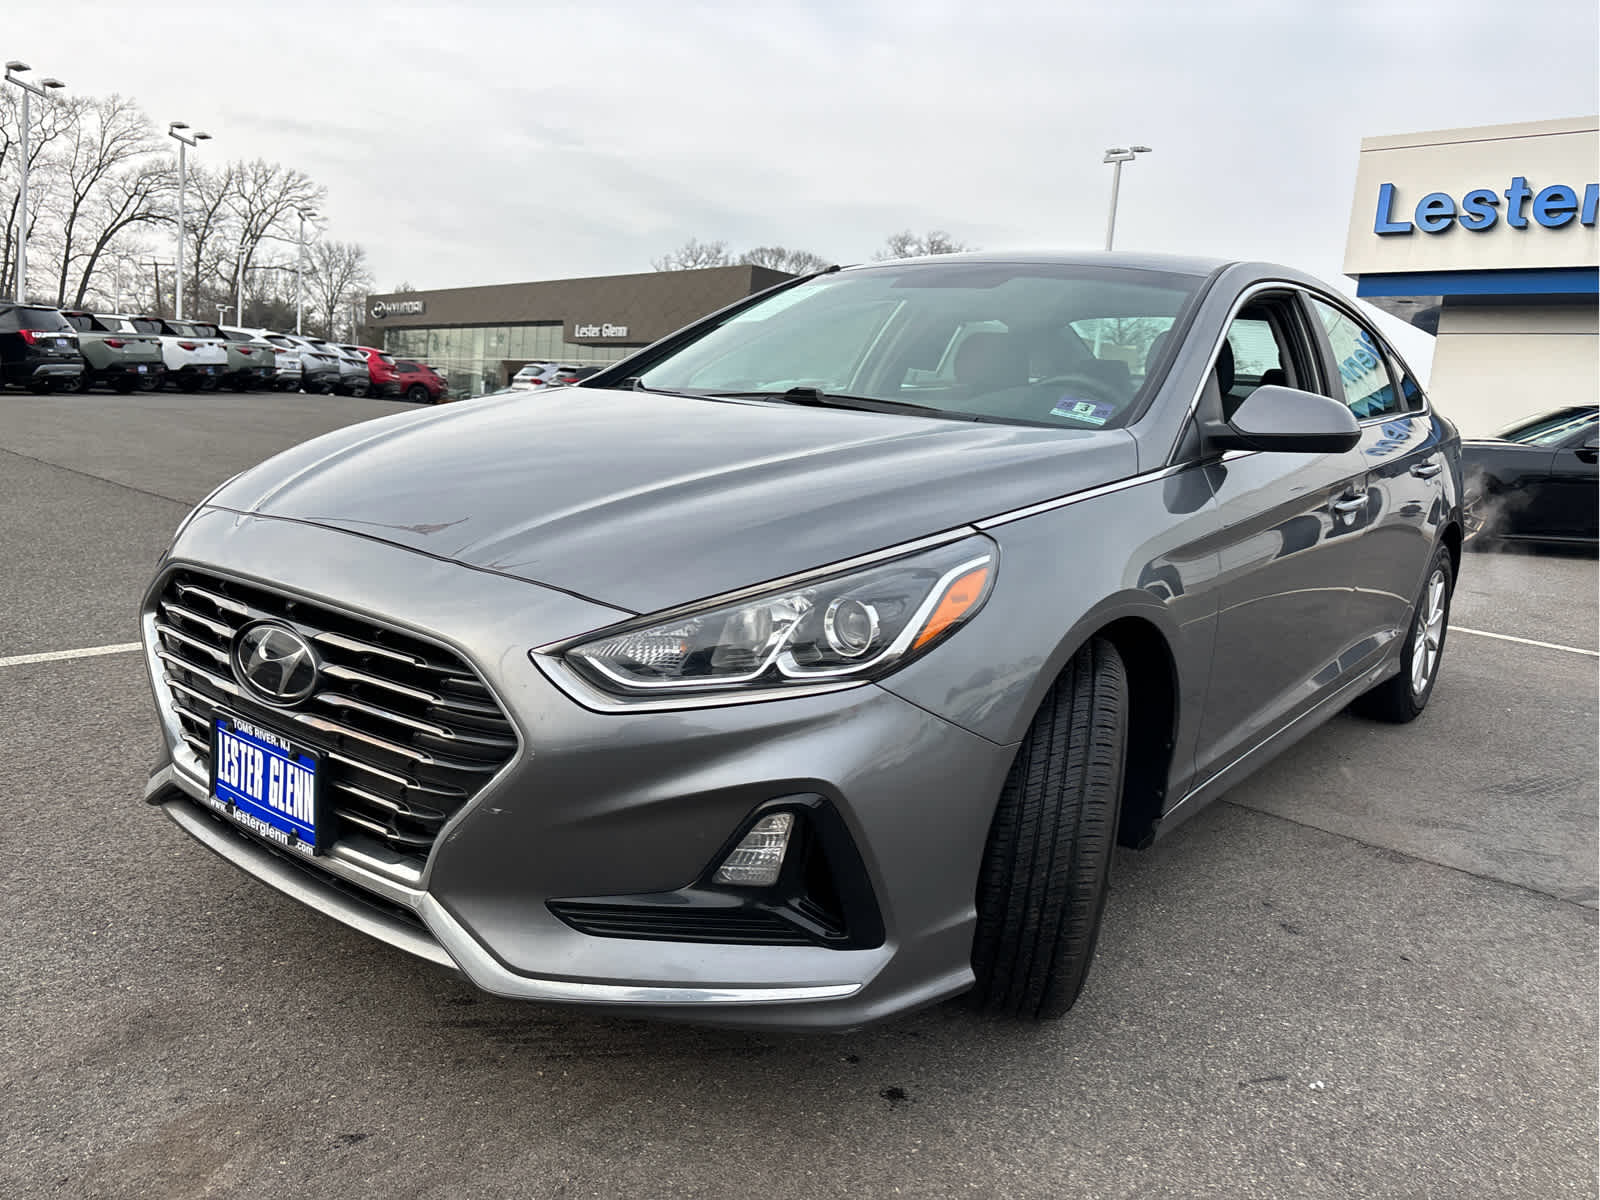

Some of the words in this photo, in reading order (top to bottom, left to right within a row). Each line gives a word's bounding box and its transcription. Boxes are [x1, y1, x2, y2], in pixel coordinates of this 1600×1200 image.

[575, 324, 600, 337] Lester
[602, 323, 628, 337] Glenn
[232, 718, 254, 736] TOMS
[280, 738, 291, 752] NJ
[217, 731, 264, 801] LESTER
[268, 755, 315, 826] GLENN
